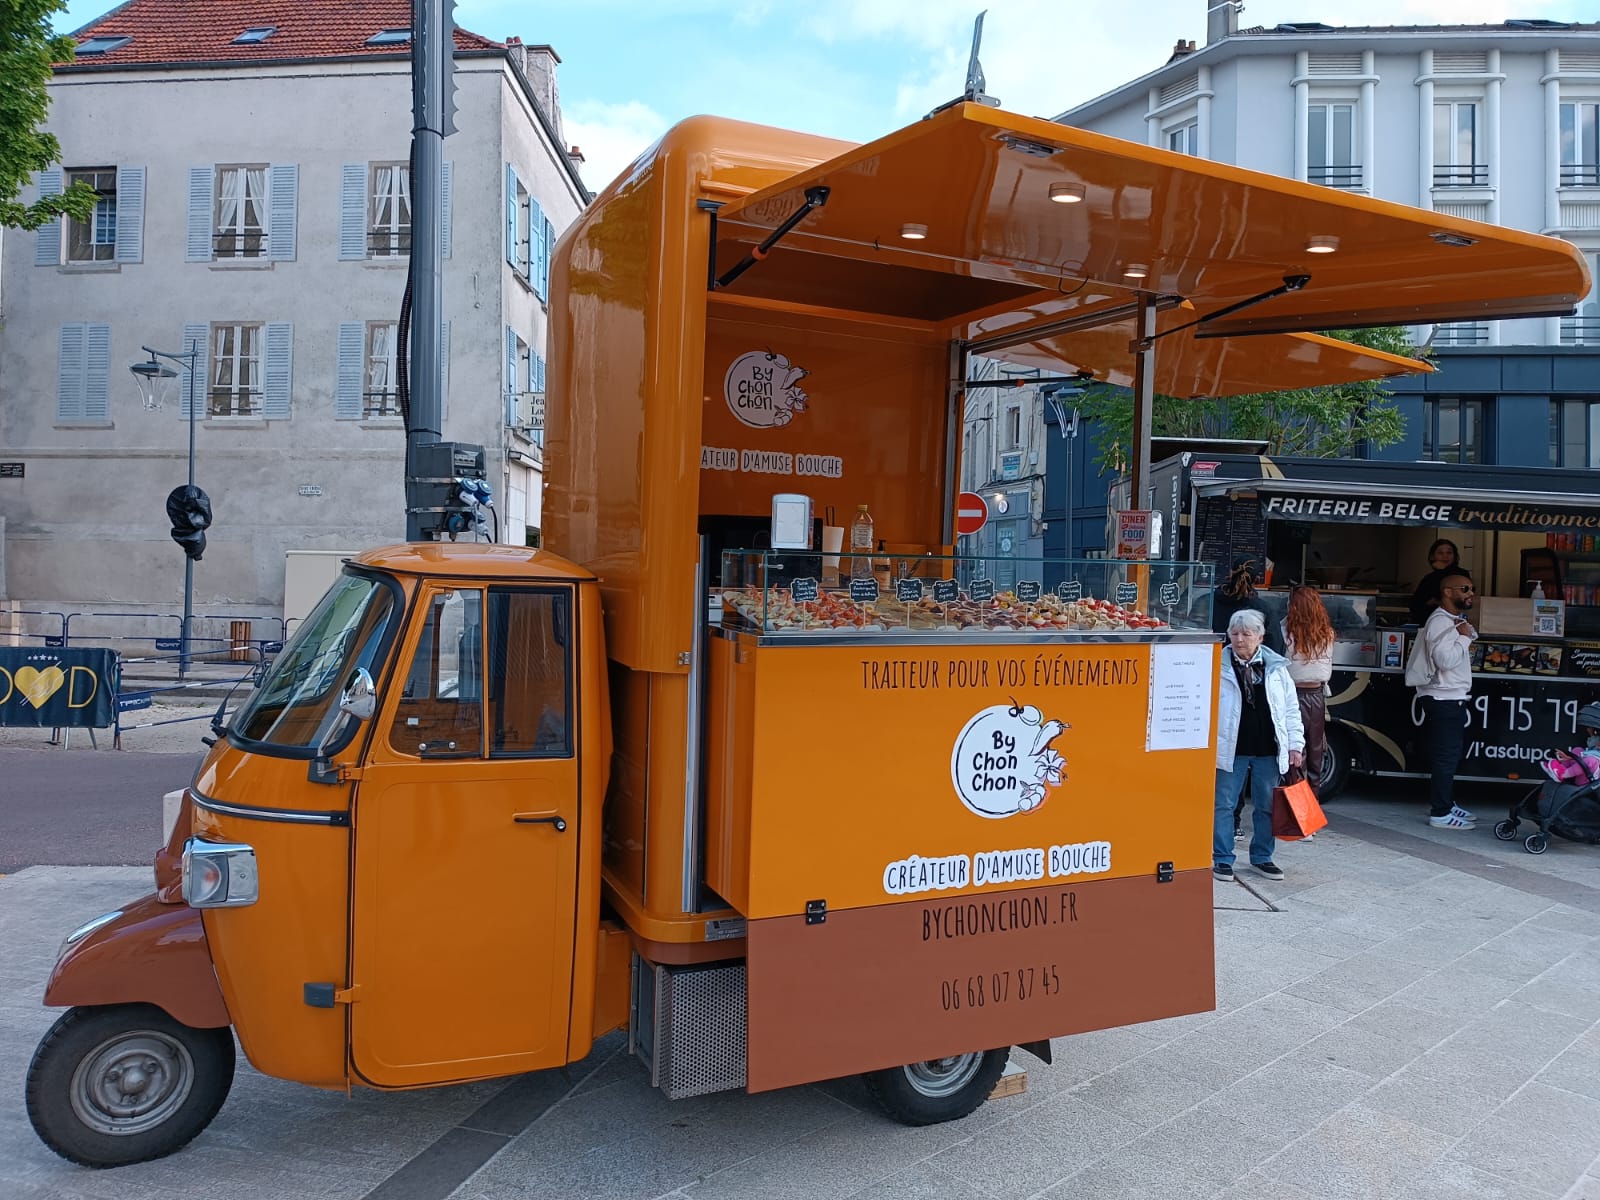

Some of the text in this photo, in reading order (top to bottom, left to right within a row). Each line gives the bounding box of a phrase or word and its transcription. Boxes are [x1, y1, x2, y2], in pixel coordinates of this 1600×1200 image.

[752, 366, 773, 381] By
[738, 380, 772, 396] Chon
[738, 395, 772, 410] Chon
[701, 449, 841, 474] ATEUR D'AMUSE BOUCHE
[1121, 515, 1146, 524] DINER
[1267, 497, 1600, 529] FRITERIE BELGE traditionne
[1122, 529, 1145, 539] FOOD
[861, 653, 1139, 690] TRAITEUR POUR VOS ÉVÉNEMENTS
[1501, 696, 1534, 731] 75
[1546, 698, 1578, 734] 79
[992, 730, 1016, 754] By
[972, 753, 1018, 772] Chon
[972, 773, 1017, 792] Chon
[888, 846, 1108, 890] CRÉATEUR D'AMUSE BOUCHE
[942, 964, 1060, 1011] 06 68 07 87 45
